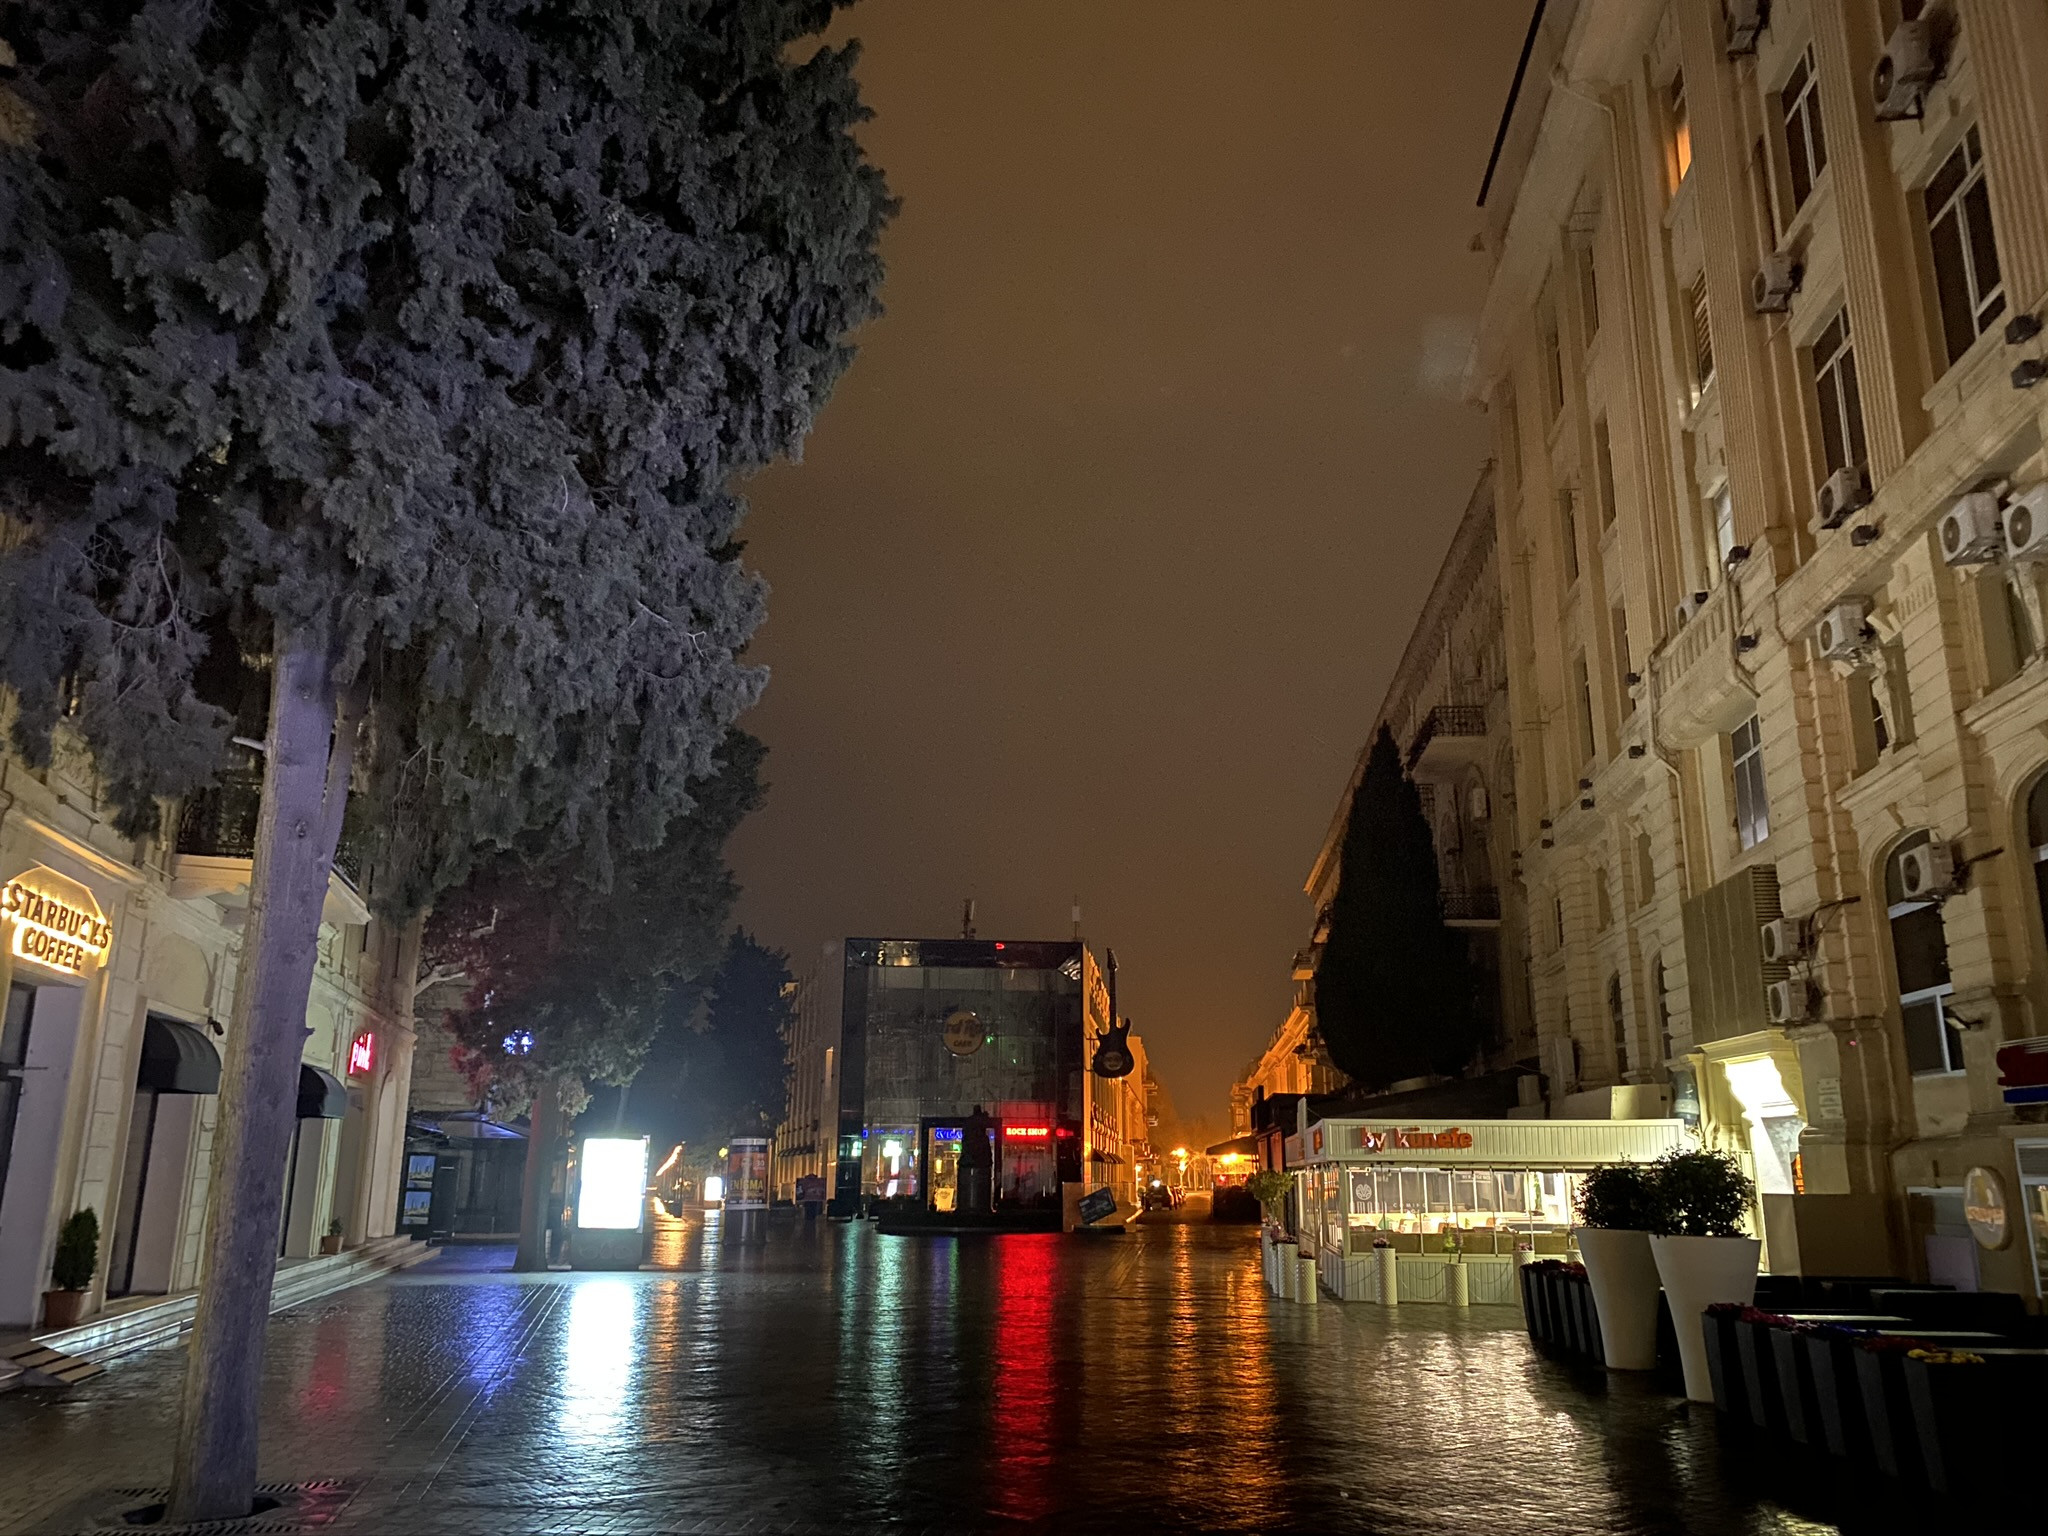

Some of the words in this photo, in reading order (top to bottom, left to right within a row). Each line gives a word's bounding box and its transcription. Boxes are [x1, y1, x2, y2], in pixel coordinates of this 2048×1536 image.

[1, 884, 110, 949] STARBUCKS
[22, 927, 84, 970] COFFEE
[1006, 1127, 1027, 1136] ROCK
[1027, 1127, 1048, 1136] SHOP
[730, 1179, 764, 1190] ENIGMA
